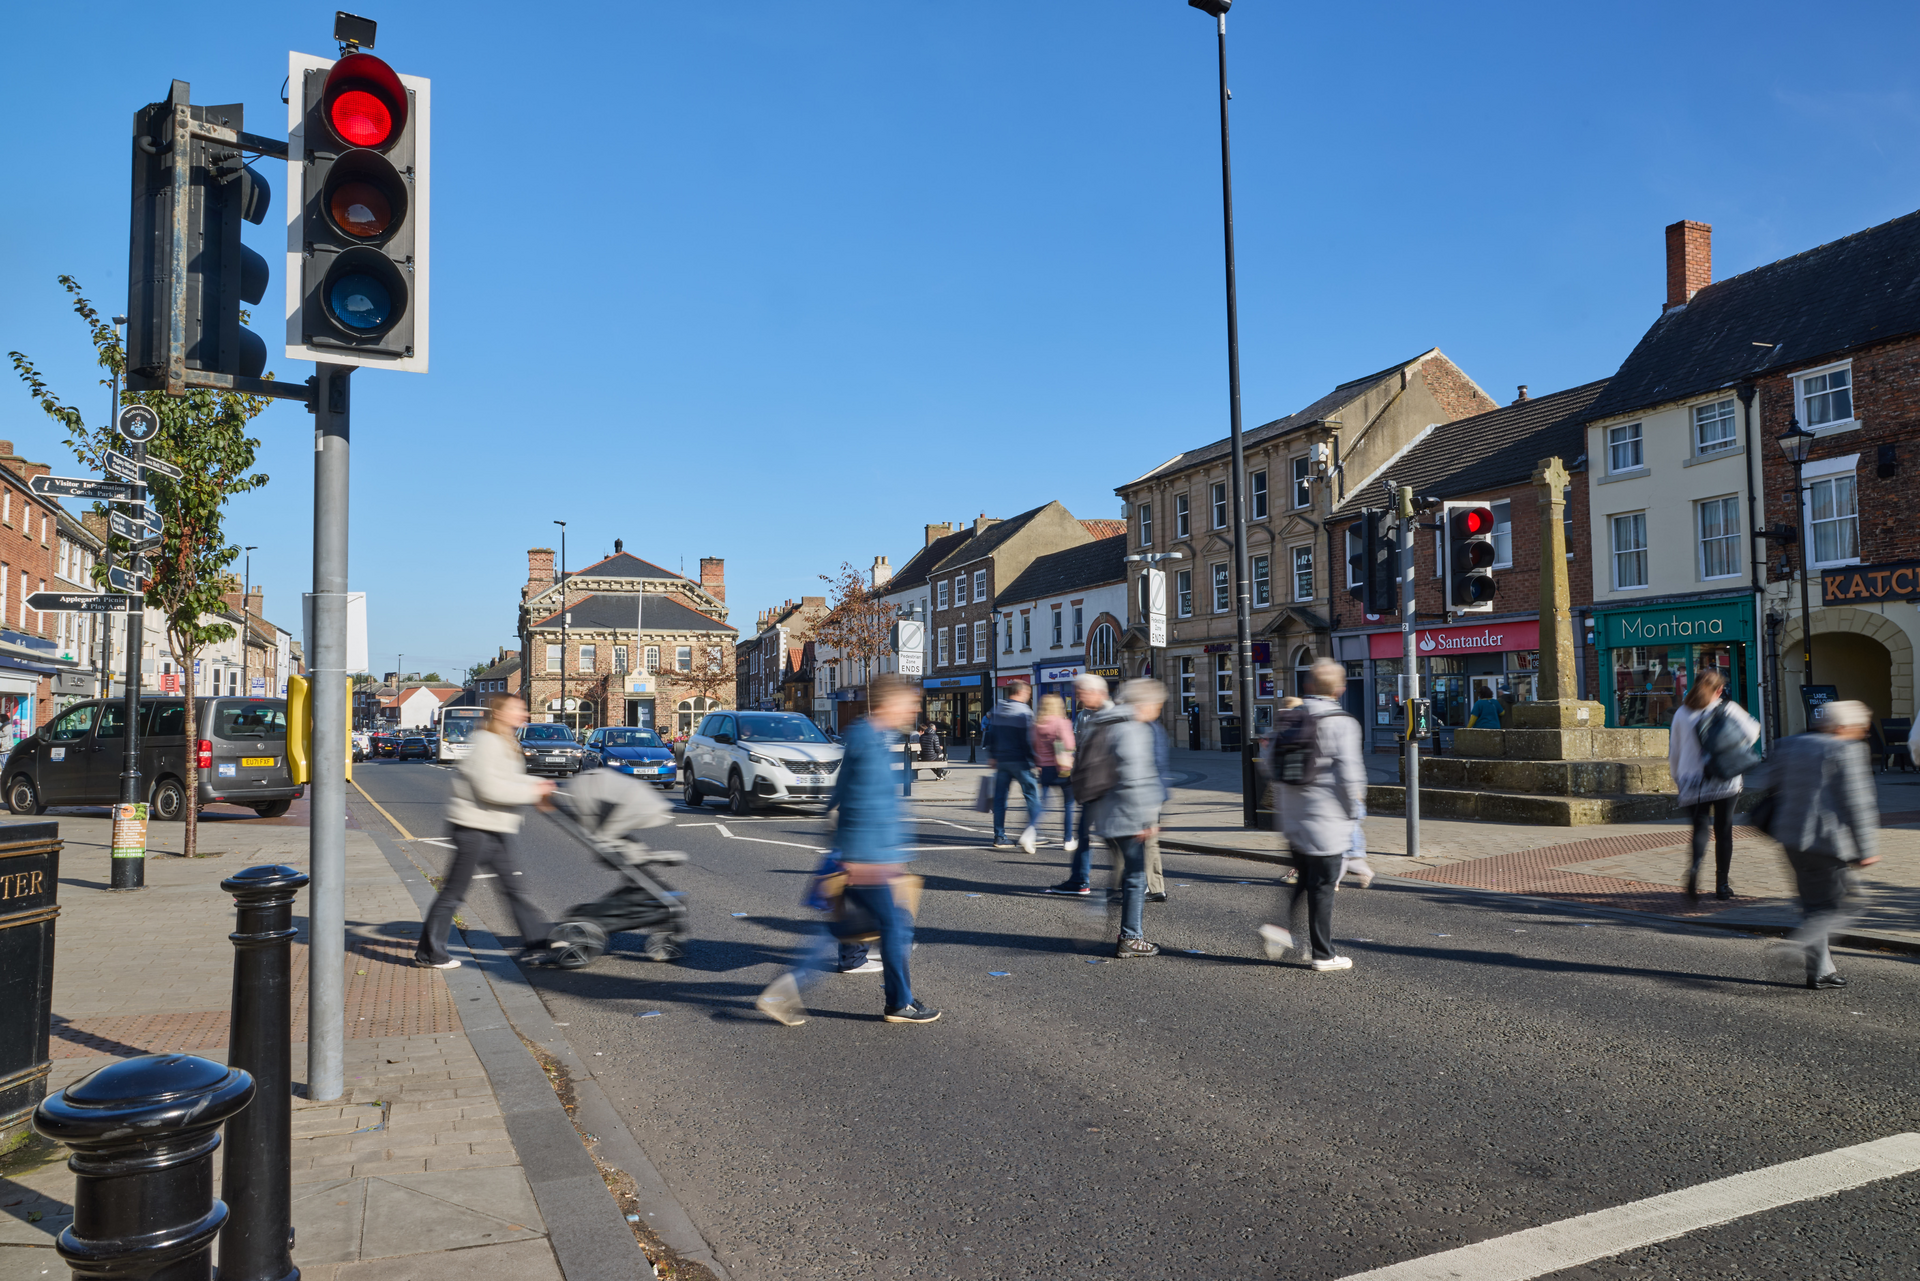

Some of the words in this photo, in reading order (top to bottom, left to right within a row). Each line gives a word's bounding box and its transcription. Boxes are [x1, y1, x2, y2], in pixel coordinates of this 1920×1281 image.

[54, 479, 79, 488] Visitor
[82, 482, 125, 491] Information
[70, 488, 92, 496] Coach
[97, 490, 125, 499] Parking
[1824, 567, 1920, 600] KATC
[60, 596, 100, 604] Applegarth
[1622, 615, 1723, 640] Montana
[1152, 633, 1165, 643] ENDS
[1438, 629, 1504, 650] Santander
[901, 665, 920, 673] ENDS
[1095, 668, 1119, 677] ARCADE
